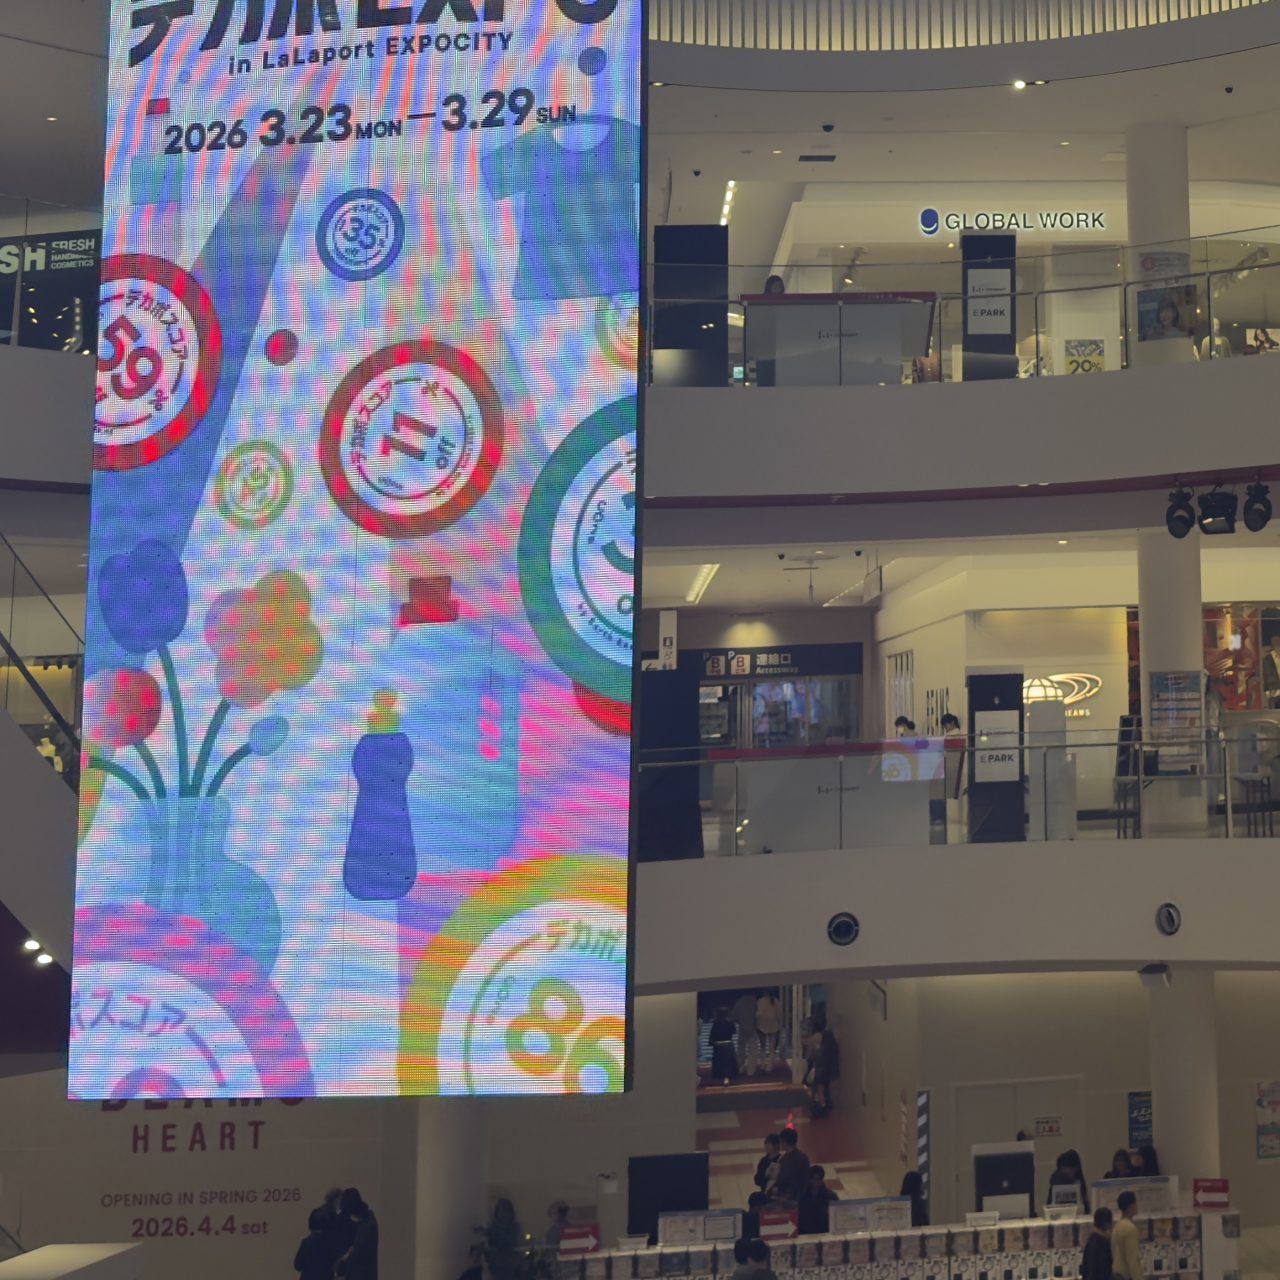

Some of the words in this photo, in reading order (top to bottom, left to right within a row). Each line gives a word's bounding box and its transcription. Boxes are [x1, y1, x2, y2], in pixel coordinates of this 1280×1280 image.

[229, 57, 251, 74] in
[262, 42, 374, 70] LaLaport
[385, 31, 514, 56] EXPOCITY
[164, 120, 248, 155] 2026
[945, 212, 1034, 230] GLOBAL
[1039, 212, 1105, 229] WORK
[52, 238, 95, 251] FRESH
[50, 259, 95, 270] COSMETICS
[132, 1119, 267, 1154] HEART
[100, 1191, 173, 1208] OPENING
[178, 1191, 194, 1206] IN
[199, 1189, 258, 1205] SPRING
[263, 1188, 302, 1203] 2026
[131, 1215, 236, 1238] 2026.4.4
[242, 1220, 268, 1235] sat
